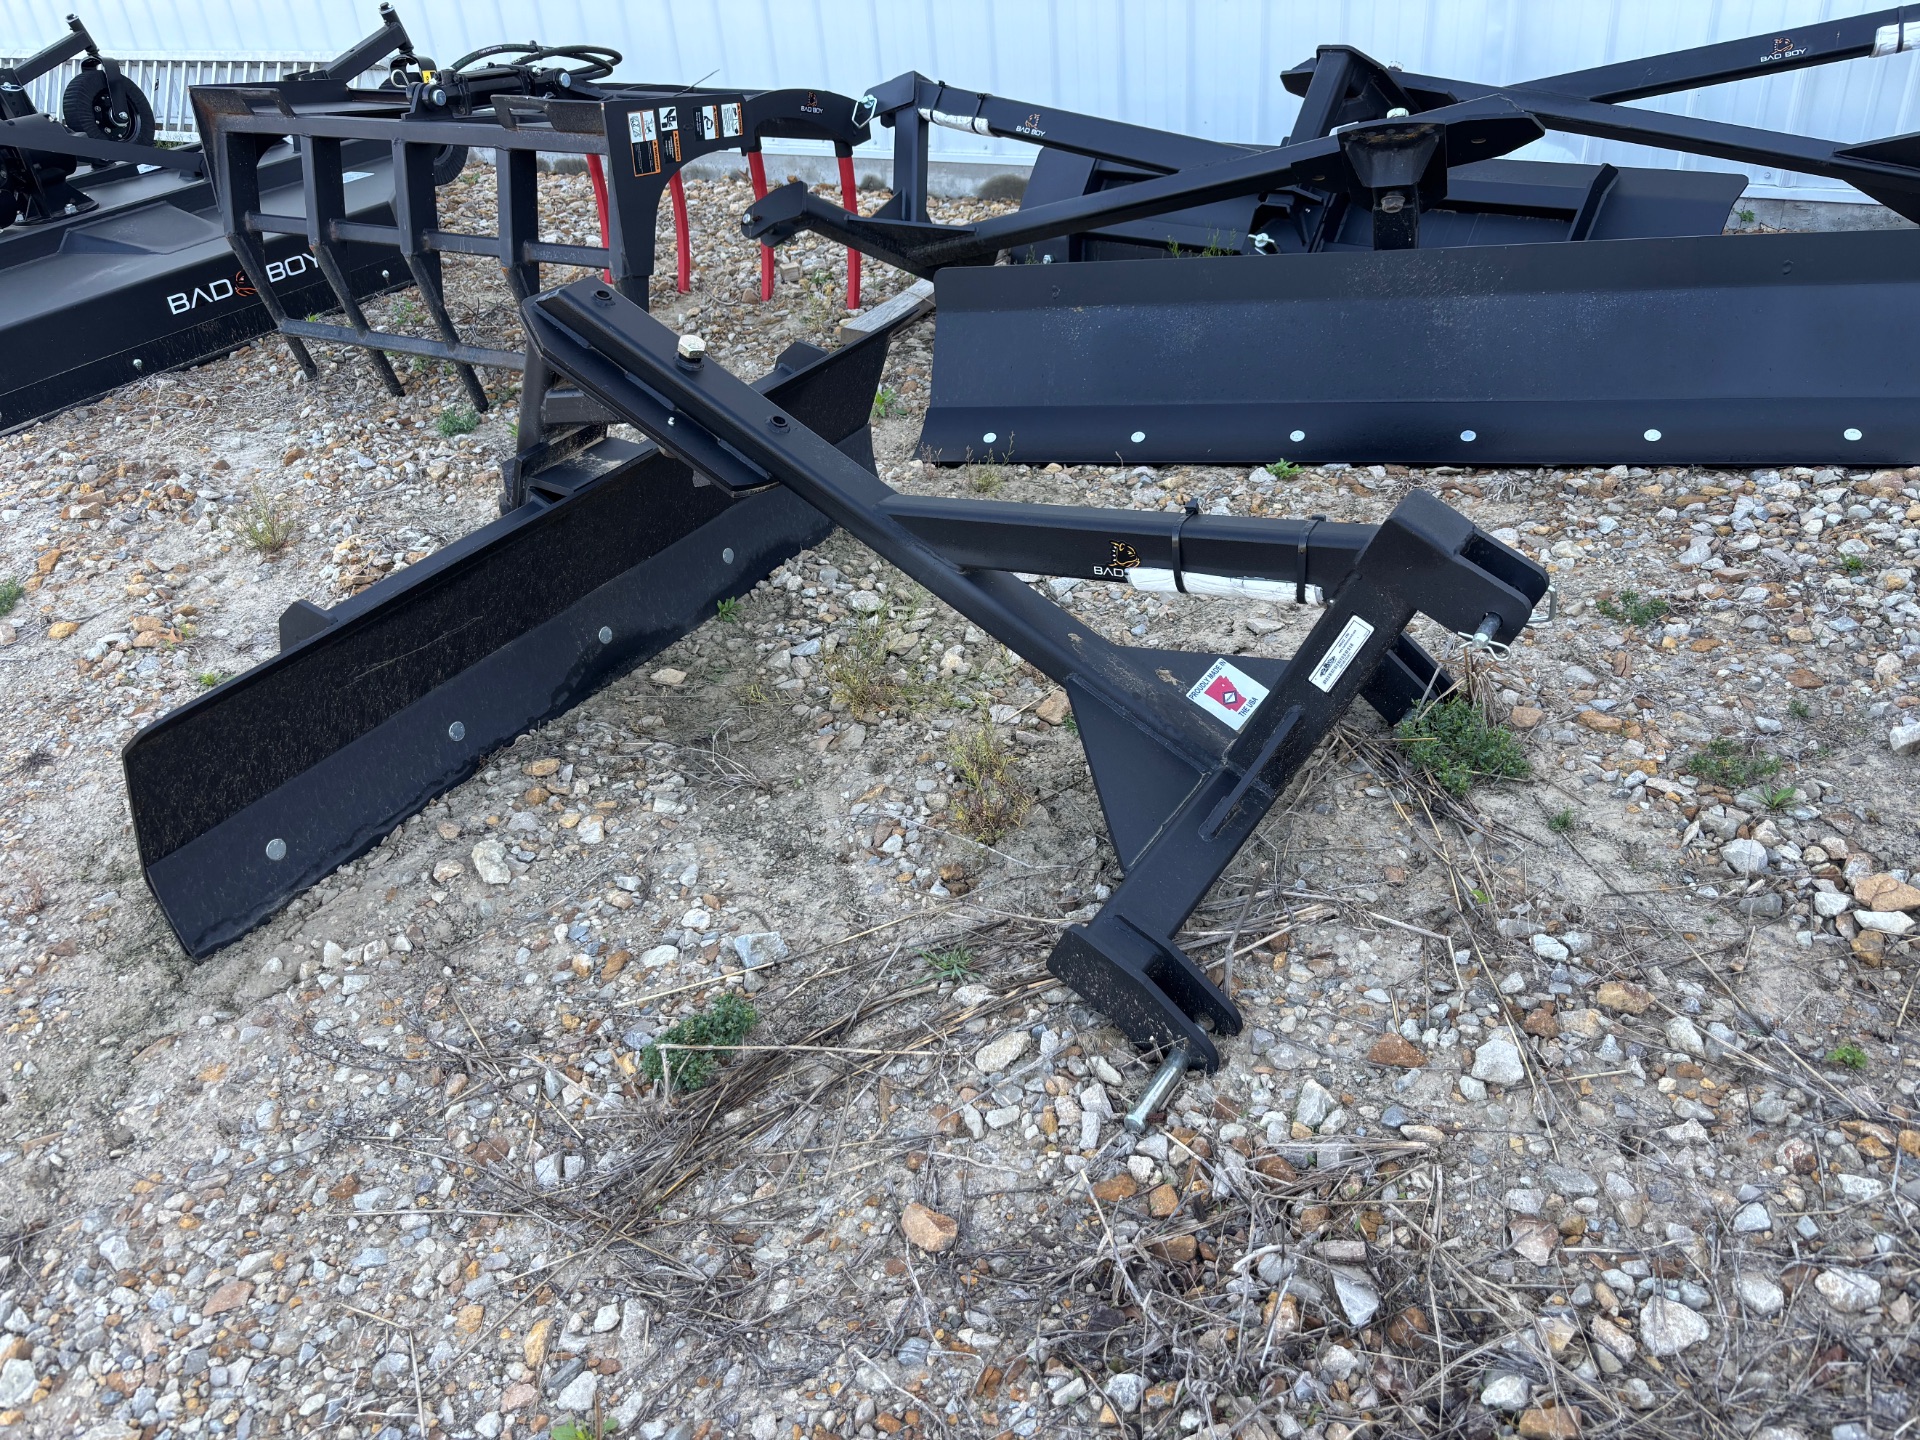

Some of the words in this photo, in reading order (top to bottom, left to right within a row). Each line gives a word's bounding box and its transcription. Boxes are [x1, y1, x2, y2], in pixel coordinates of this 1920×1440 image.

[1760, 53, 1782, 63] BAD
[1785, 47, 1807, 58] BOY
[1015, 125, 1030, 134] BAD
[1031, 128, 1046, 137] BOY
[166, 278, 233, 315] BAD
[1093, 565, 1124, 578] BAD
[1189, 677, 1210, 700] PROUDLY
[1207, 664, 1223, 679] MADE
[1220, 660, 1226, 668] IN
[1238, 706, 1250, 717] THE
[1247, 697, 1258, 708] USA
